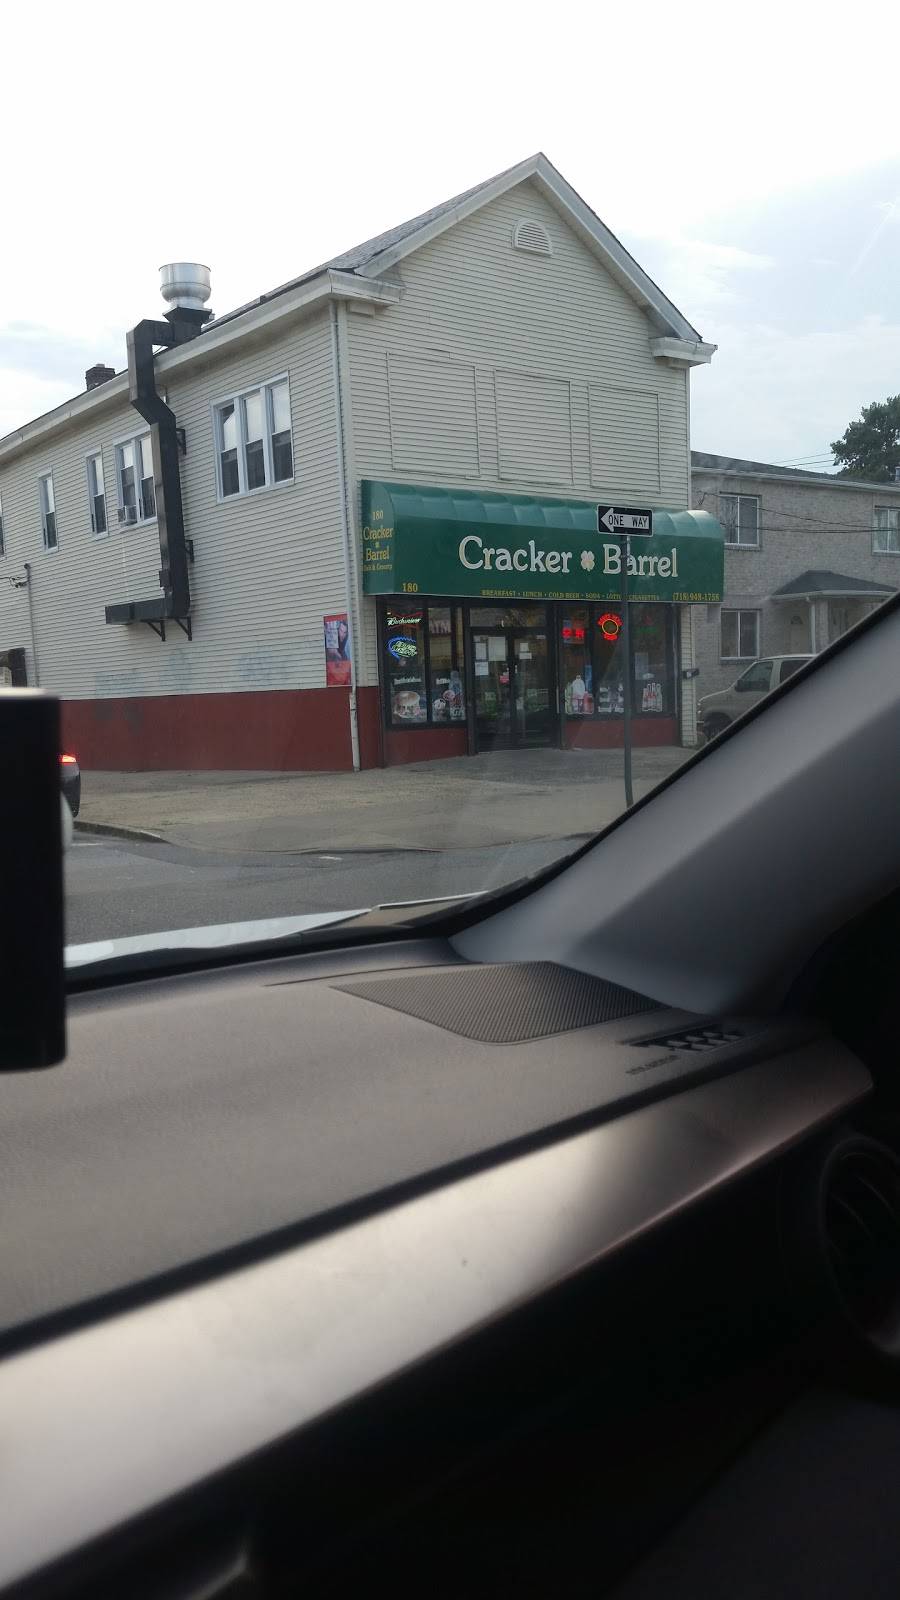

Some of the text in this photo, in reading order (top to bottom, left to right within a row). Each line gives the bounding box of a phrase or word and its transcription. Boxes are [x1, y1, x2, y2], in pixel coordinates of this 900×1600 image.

[372, 510, 384, 521] 180
[608, 514, 648, 528] ONE WAY
[362, 525, 394, 541] Cracker
[365, 545, 390, 562] Barrel
[458, 535, 679, 578] Cracker Barrel
[402, 582, 418, 593] 180
[481, 589, 516, 597] BREAKFAST
[522, 590, 543, 598] LUNCH
